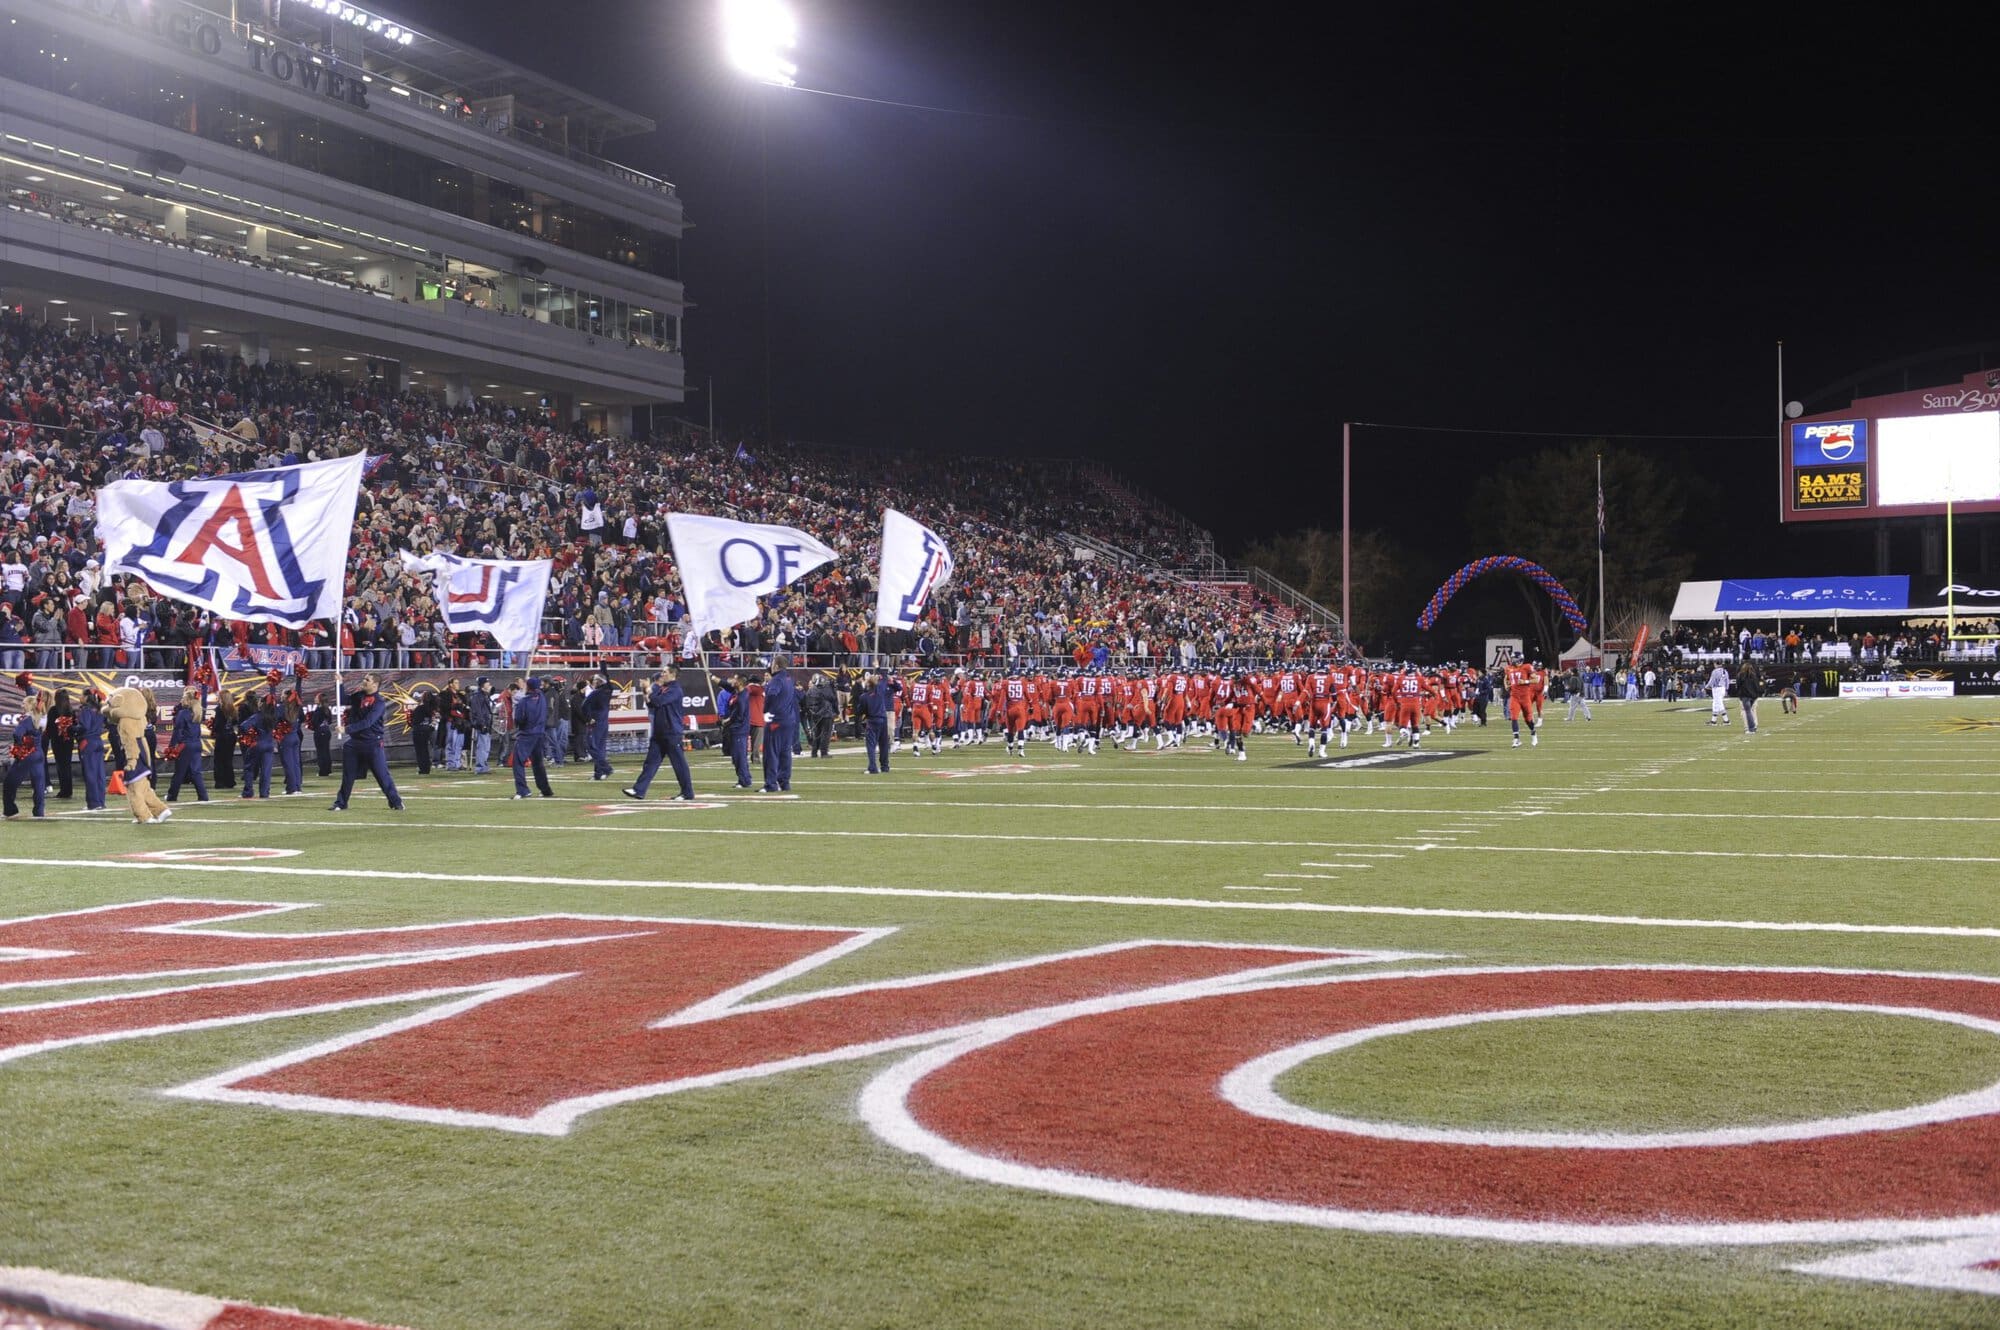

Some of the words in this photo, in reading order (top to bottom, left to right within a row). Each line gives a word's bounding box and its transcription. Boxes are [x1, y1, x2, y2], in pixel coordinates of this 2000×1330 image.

[248, 44, 371, 109] TOWER
[1923, 393, 1957, 409] Sam
[1804, 424, 1855, 439] PEPSI
[1800, 473, 1861, 487] SAM'S
[1800, 485, 1860, 498] TOWN
[119, 468, 326, 624] A
[719, 538, 802, 589] OF
[124, 675, 185, 688] Pionee
[1316, 679, 1325, 694] 5
[1402, 679, 1418, 693] 36
[682, 696, 709, 708] eer
